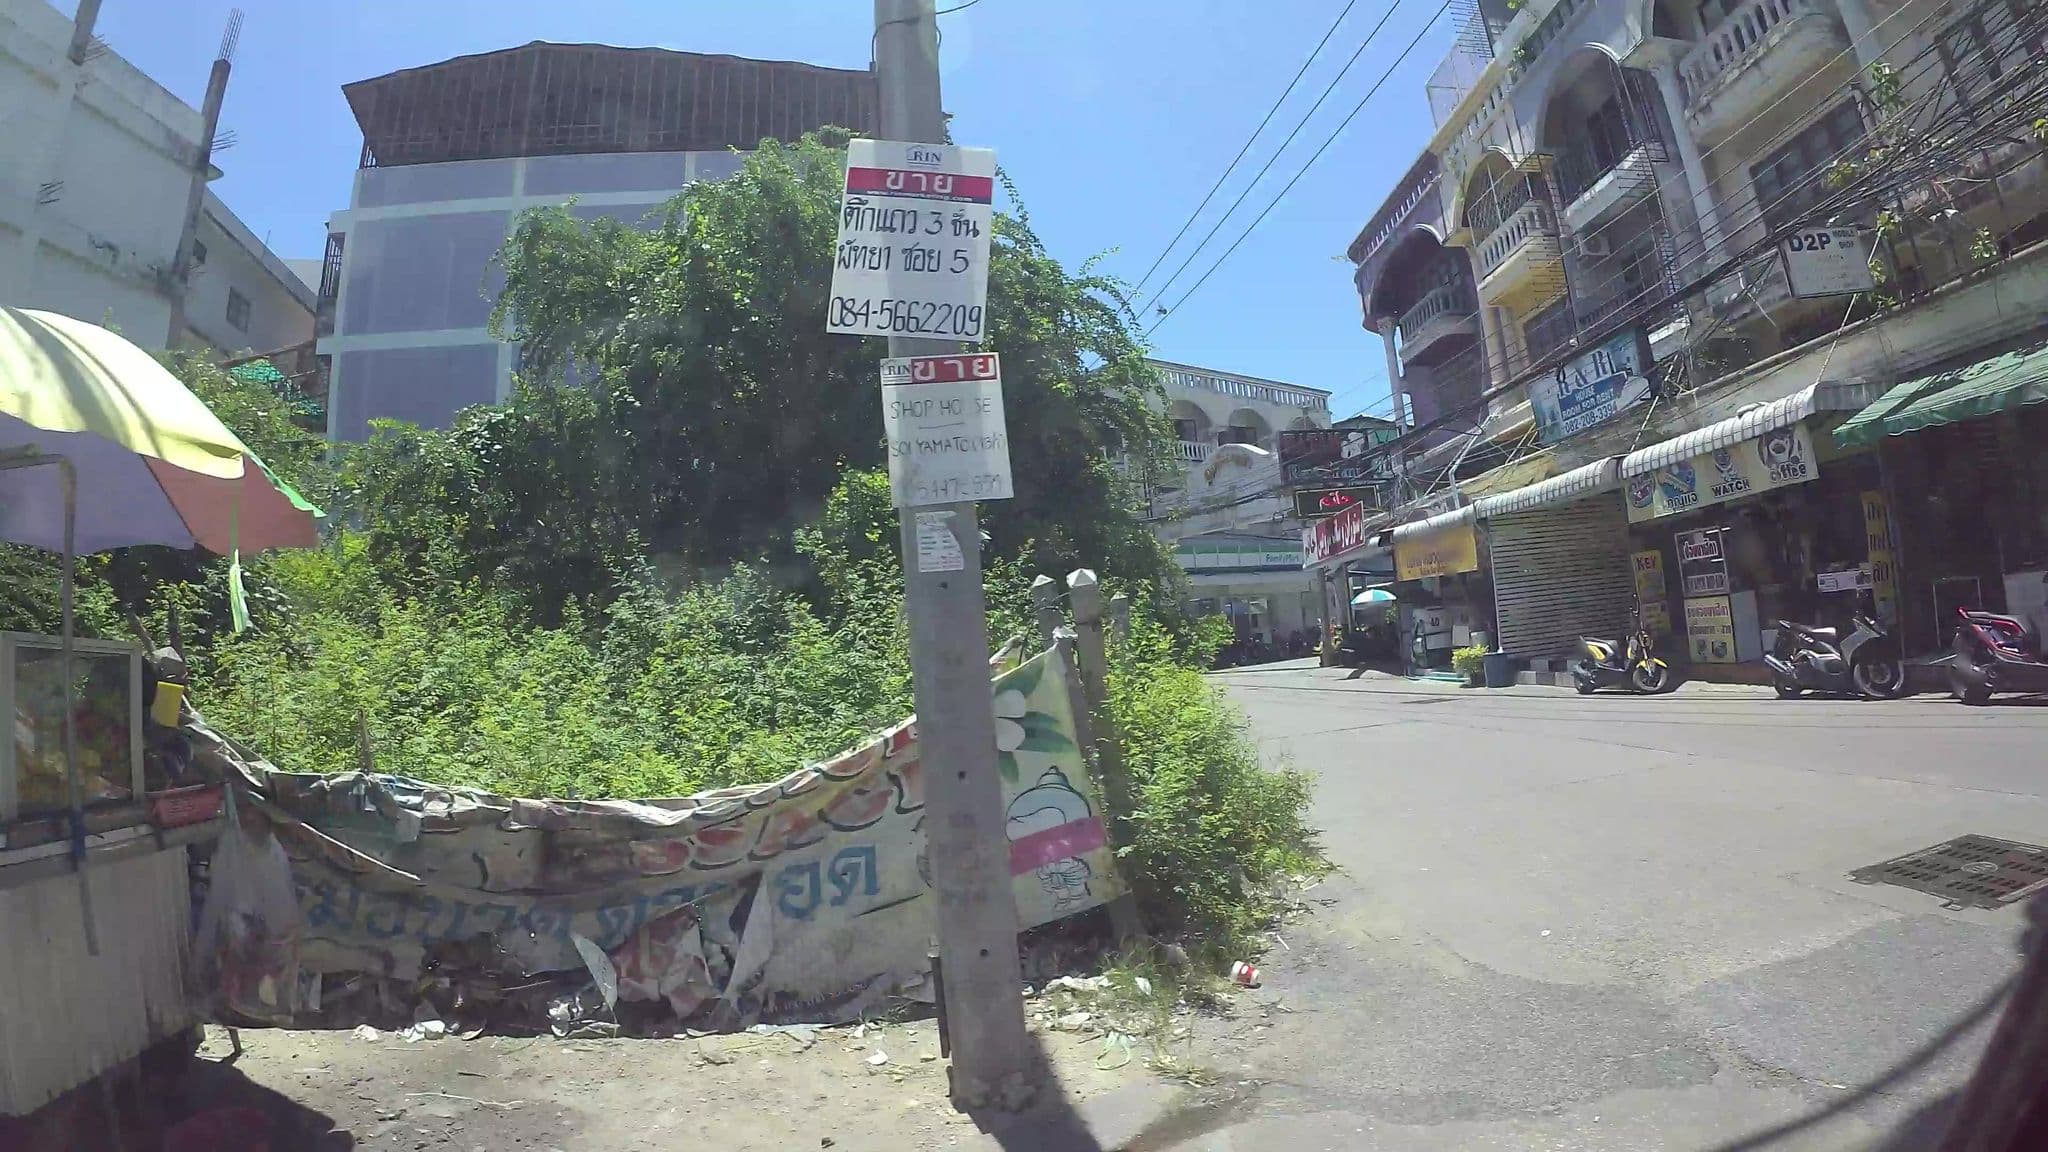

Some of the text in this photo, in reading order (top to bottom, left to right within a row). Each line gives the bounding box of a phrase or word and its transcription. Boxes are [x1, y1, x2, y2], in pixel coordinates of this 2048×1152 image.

[913, 150, 942, 163] RIN
[886, 171, 953, 194] ขาย
[924, 211, 943, 235] 3
[1788, 232, 1831, 252] D2P
[949, 249, 969, 274] 5
[829, 297, 983, 336] 084-5662209
[887, 365, 911, 376] RIN
[913, 358, 996, 381] ขาย
[1575, 385, 1595, 401] HOUSE
[890, 397, 992, 419] SHOP HOSE
[1711, 479, 1751, 498] WATCH
[1636, 556, 1656, 571] KEY
